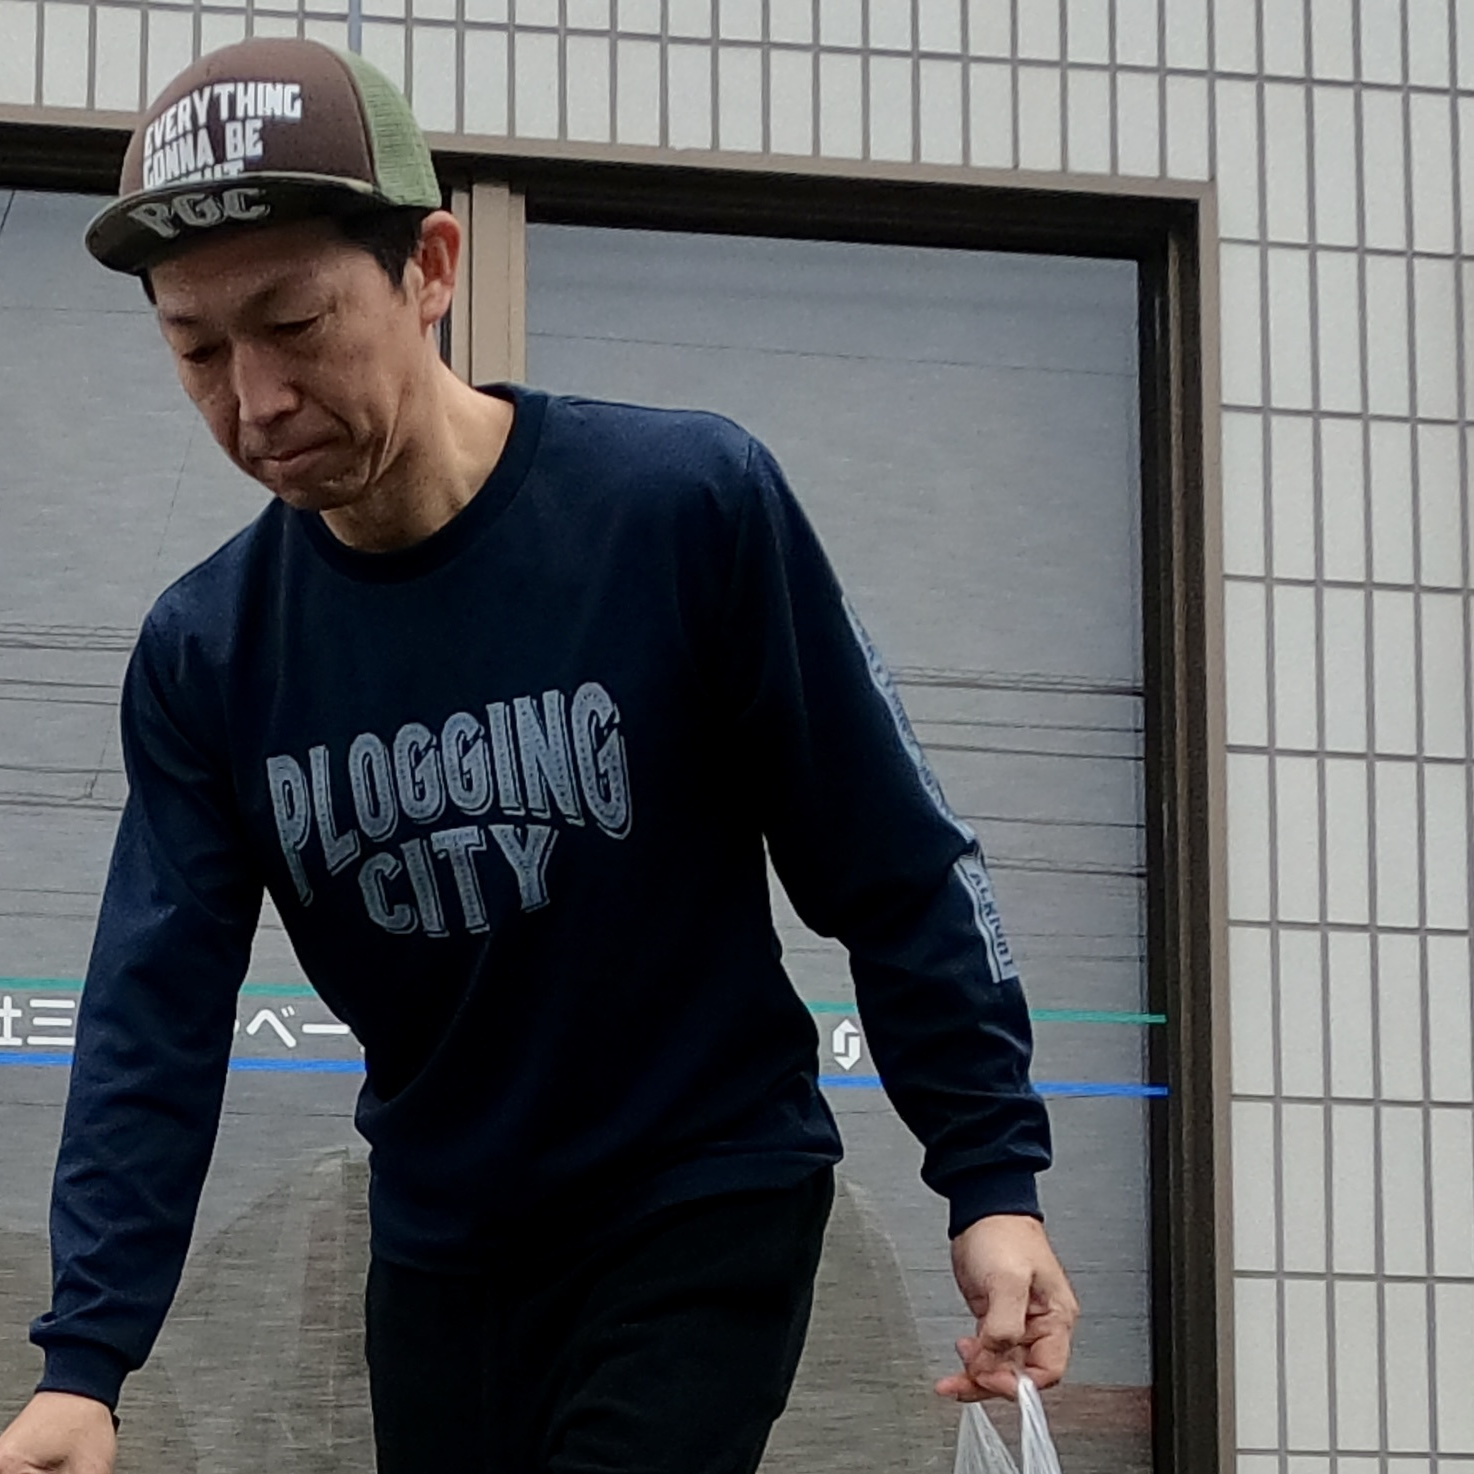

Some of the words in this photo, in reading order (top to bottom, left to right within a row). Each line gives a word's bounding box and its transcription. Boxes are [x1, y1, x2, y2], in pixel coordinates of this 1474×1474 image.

[143, 128, 214, 191] GONNA
[226, 119, 263, 158] BE
[144, 82, 302, 158] EVERYTHING
[266, 682, 633, 906] PLOGGING
[358, 824, 559, 937] CITY
